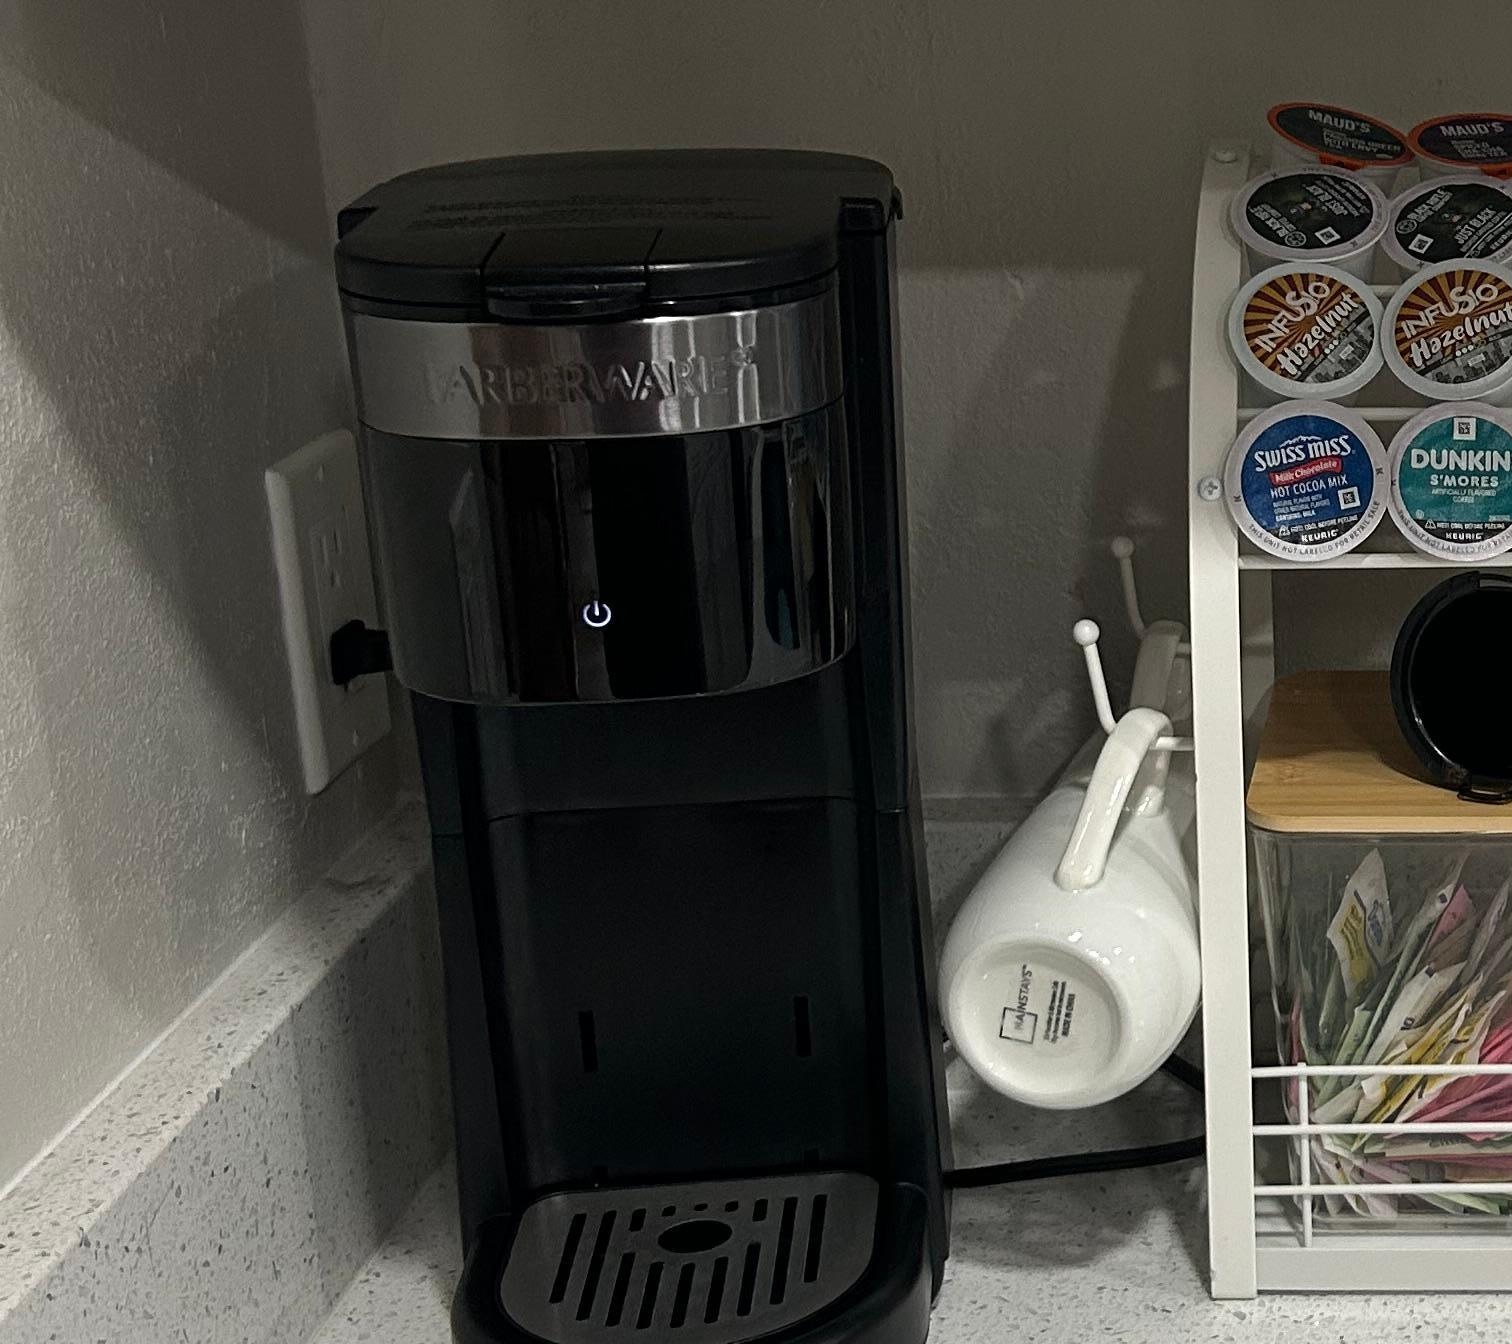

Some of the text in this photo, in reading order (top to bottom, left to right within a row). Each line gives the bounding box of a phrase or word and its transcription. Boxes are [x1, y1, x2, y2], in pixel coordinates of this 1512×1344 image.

[1308, 109, 1371, 134] MAUD'S
[1440, 122, 1504, 137] MAUD'S
[1454, 223, 1477, 245] JUST
[1469, 207, 1497, 228] BLACK
[1253, 281, 1330, 353] INFUSIO
[1400, 282, 1499, 338] INFUSIO
[1276, 292, 1360, 377] Hazelnut
[1254, 435, 1351, 472] SWISS MISS
[1270, 474, 1349, 499] HOT COCOA MIX
[1430, 474, 1499, 487] S'MORES
[1301, 531, 1338, 543] KEURIG
[1335, 537, 1349, 550] FOR
[1445, 532, 1484, 540] KEURIG
[1014, 969, 1032, 1031] MAINSTAYS
